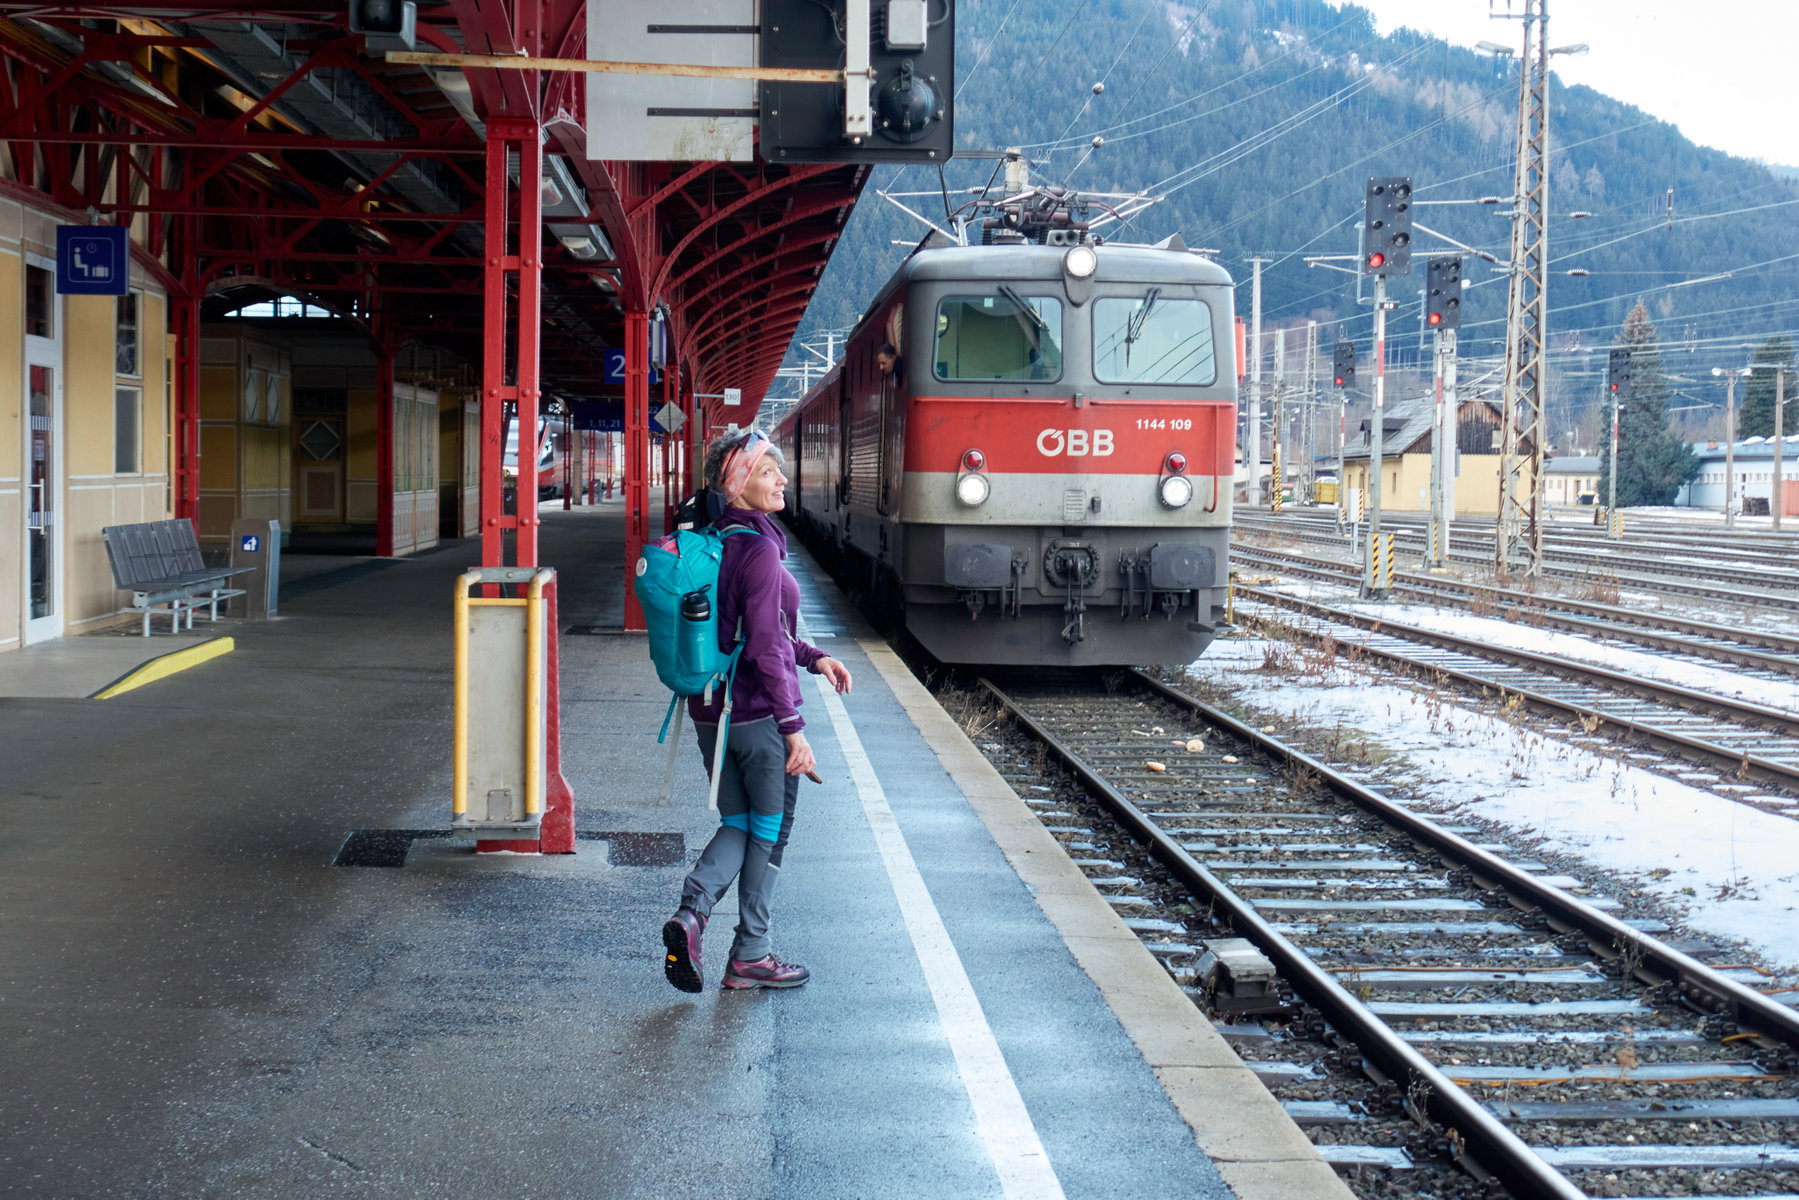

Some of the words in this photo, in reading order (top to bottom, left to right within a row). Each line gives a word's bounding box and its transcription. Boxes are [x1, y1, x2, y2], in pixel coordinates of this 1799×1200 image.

[610, 419, 621, 428] 21
[1136, 419, 1166, 430] 1144
[1169, 419, 1193, 431] 109
[1036, 428, 1115, 457] ÖBB
